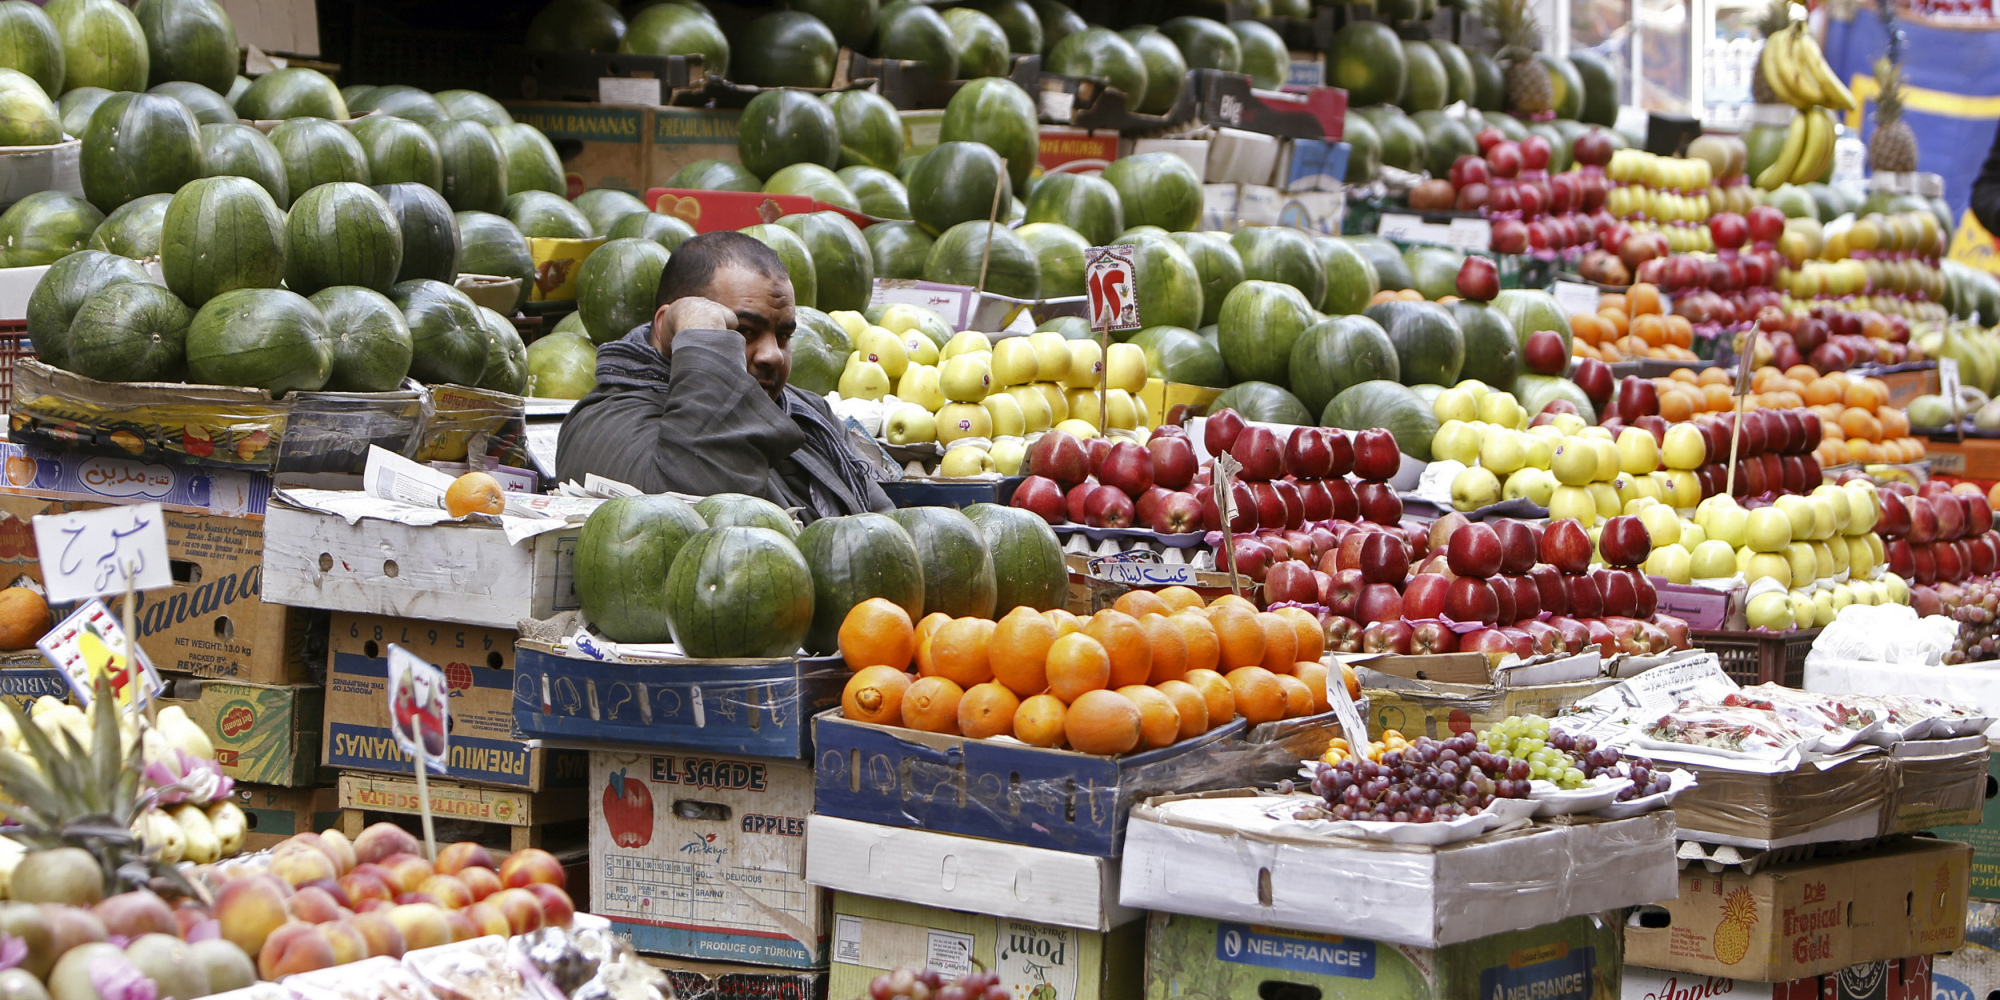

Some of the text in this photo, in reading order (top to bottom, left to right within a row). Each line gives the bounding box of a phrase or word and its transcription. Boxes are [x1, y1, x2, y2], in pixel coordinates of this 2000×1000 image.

[567, 115, 636, 136] BANANAS
[659, 117, 712, 137] PREMIUM
[223, 535, 243, 546] ARABIA
[175, 637, 190, 646] NET
[191, 640, 222, 652] WEIGHT:
[241, 645, 252, 657] kg
[188, 652, 215, 663] PACKED
[0, 677, 63, 696] SABRO
[332, 678, 385, 690] THE PHILIPPINES
[349, 686, 373, 696] PRODUCT
[450, 744, 527, 776] PREMIU
[651, 755, 768, 792] EL SAADE
[359, 789, 420, 810] SCELTA
[741, 813, 805, 838] APPLES
[725, 872, 762, 883] DELICIOUS
[606, 893, 637, 903] DELICIOUS
[616, 886, 628, 894] RED
[695, 889, 724, 898] GRANNY
[1804, 881, 1826, 900] Dole
[1783, 901, 1842, 937] Tropical
[1920, 926, 1956, 944] PINEAPPLES
[700, 940, 805, 960] PRODUCE OF TÜRKİYE
[1247, 939, 1361, 967] NELFRANCE
[1507, 972, 1583, 1000] NELFRANCE
[1643, 975, 1734, 1000] Apples
